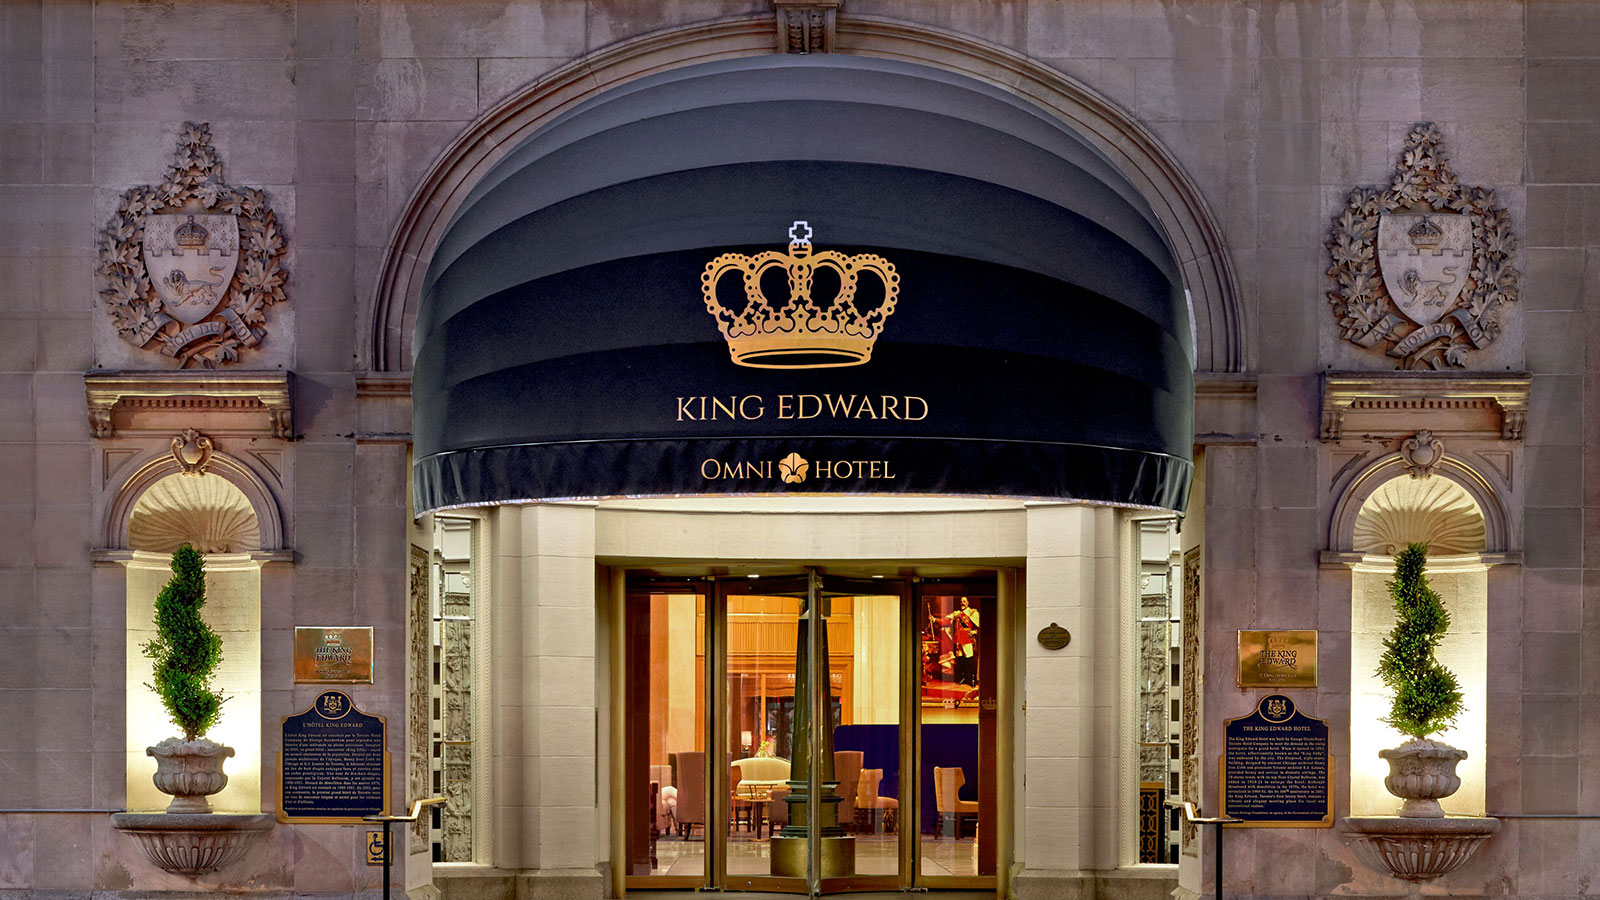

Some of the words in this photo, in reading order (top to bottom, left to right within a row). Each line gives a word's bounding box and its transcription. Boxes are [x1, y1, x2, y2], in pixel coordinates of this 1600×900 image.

[139, 319, 157, 344] AU
[161, 329, 195, 357] NOM
[200, 322, 222, 335] DU
[1372, 318, 1391, 342] AU
[1400, 330, 1428, 354] NOM
[676, 395, 766, 422] KING
[776, 394, 929, 421] EDWARD
[700, 458, 773, 480] OMNI
[815, 460, 896, 479] HOTEL
[316, 655, 352, 664] EDWARD
[332, 647, 352, 656] KING
[1260, 650, 1277, 658] THE
[1277, 650, 1297, 659] KING
[1261, 658, 1298, 668] EDWARD
